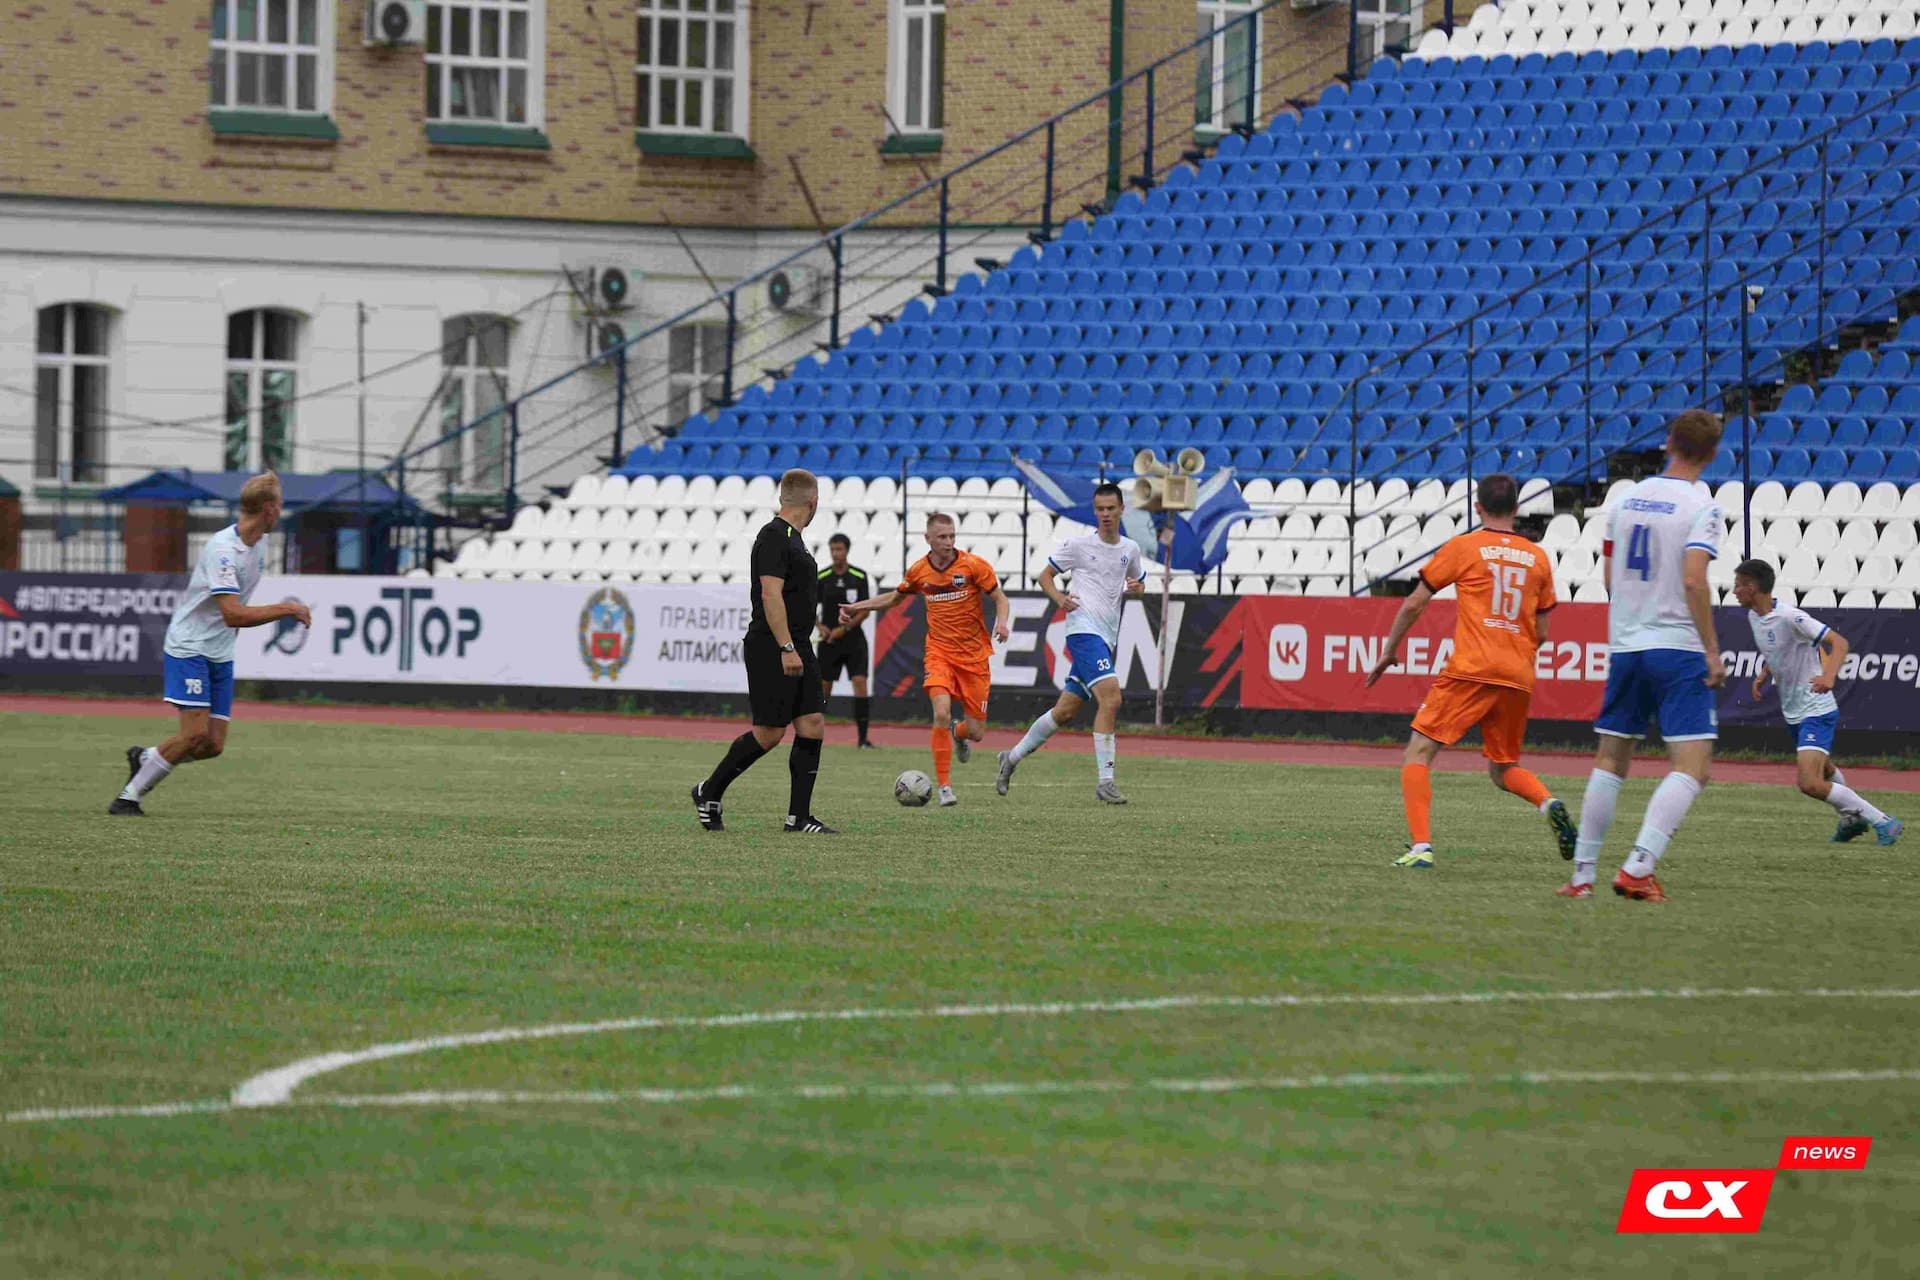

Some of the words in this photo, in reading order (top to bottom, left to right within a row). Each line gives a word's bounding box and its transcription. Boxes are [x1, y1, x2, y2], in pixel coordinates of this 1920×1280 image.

[1627, 523, 1651, 581] 4
[1487, 562, 1527, 621] 15
[332, 586, 483, 672] РОТОР
[660, 605, 750, 630] ПРАВИТЕ
[0, 621, 140, 661] РОССИЯ
[658, 634, 746, 664] АЛТАЙСК
[1096, 657, 1112, 672] 33
[185, 678, 203, 695] 78
